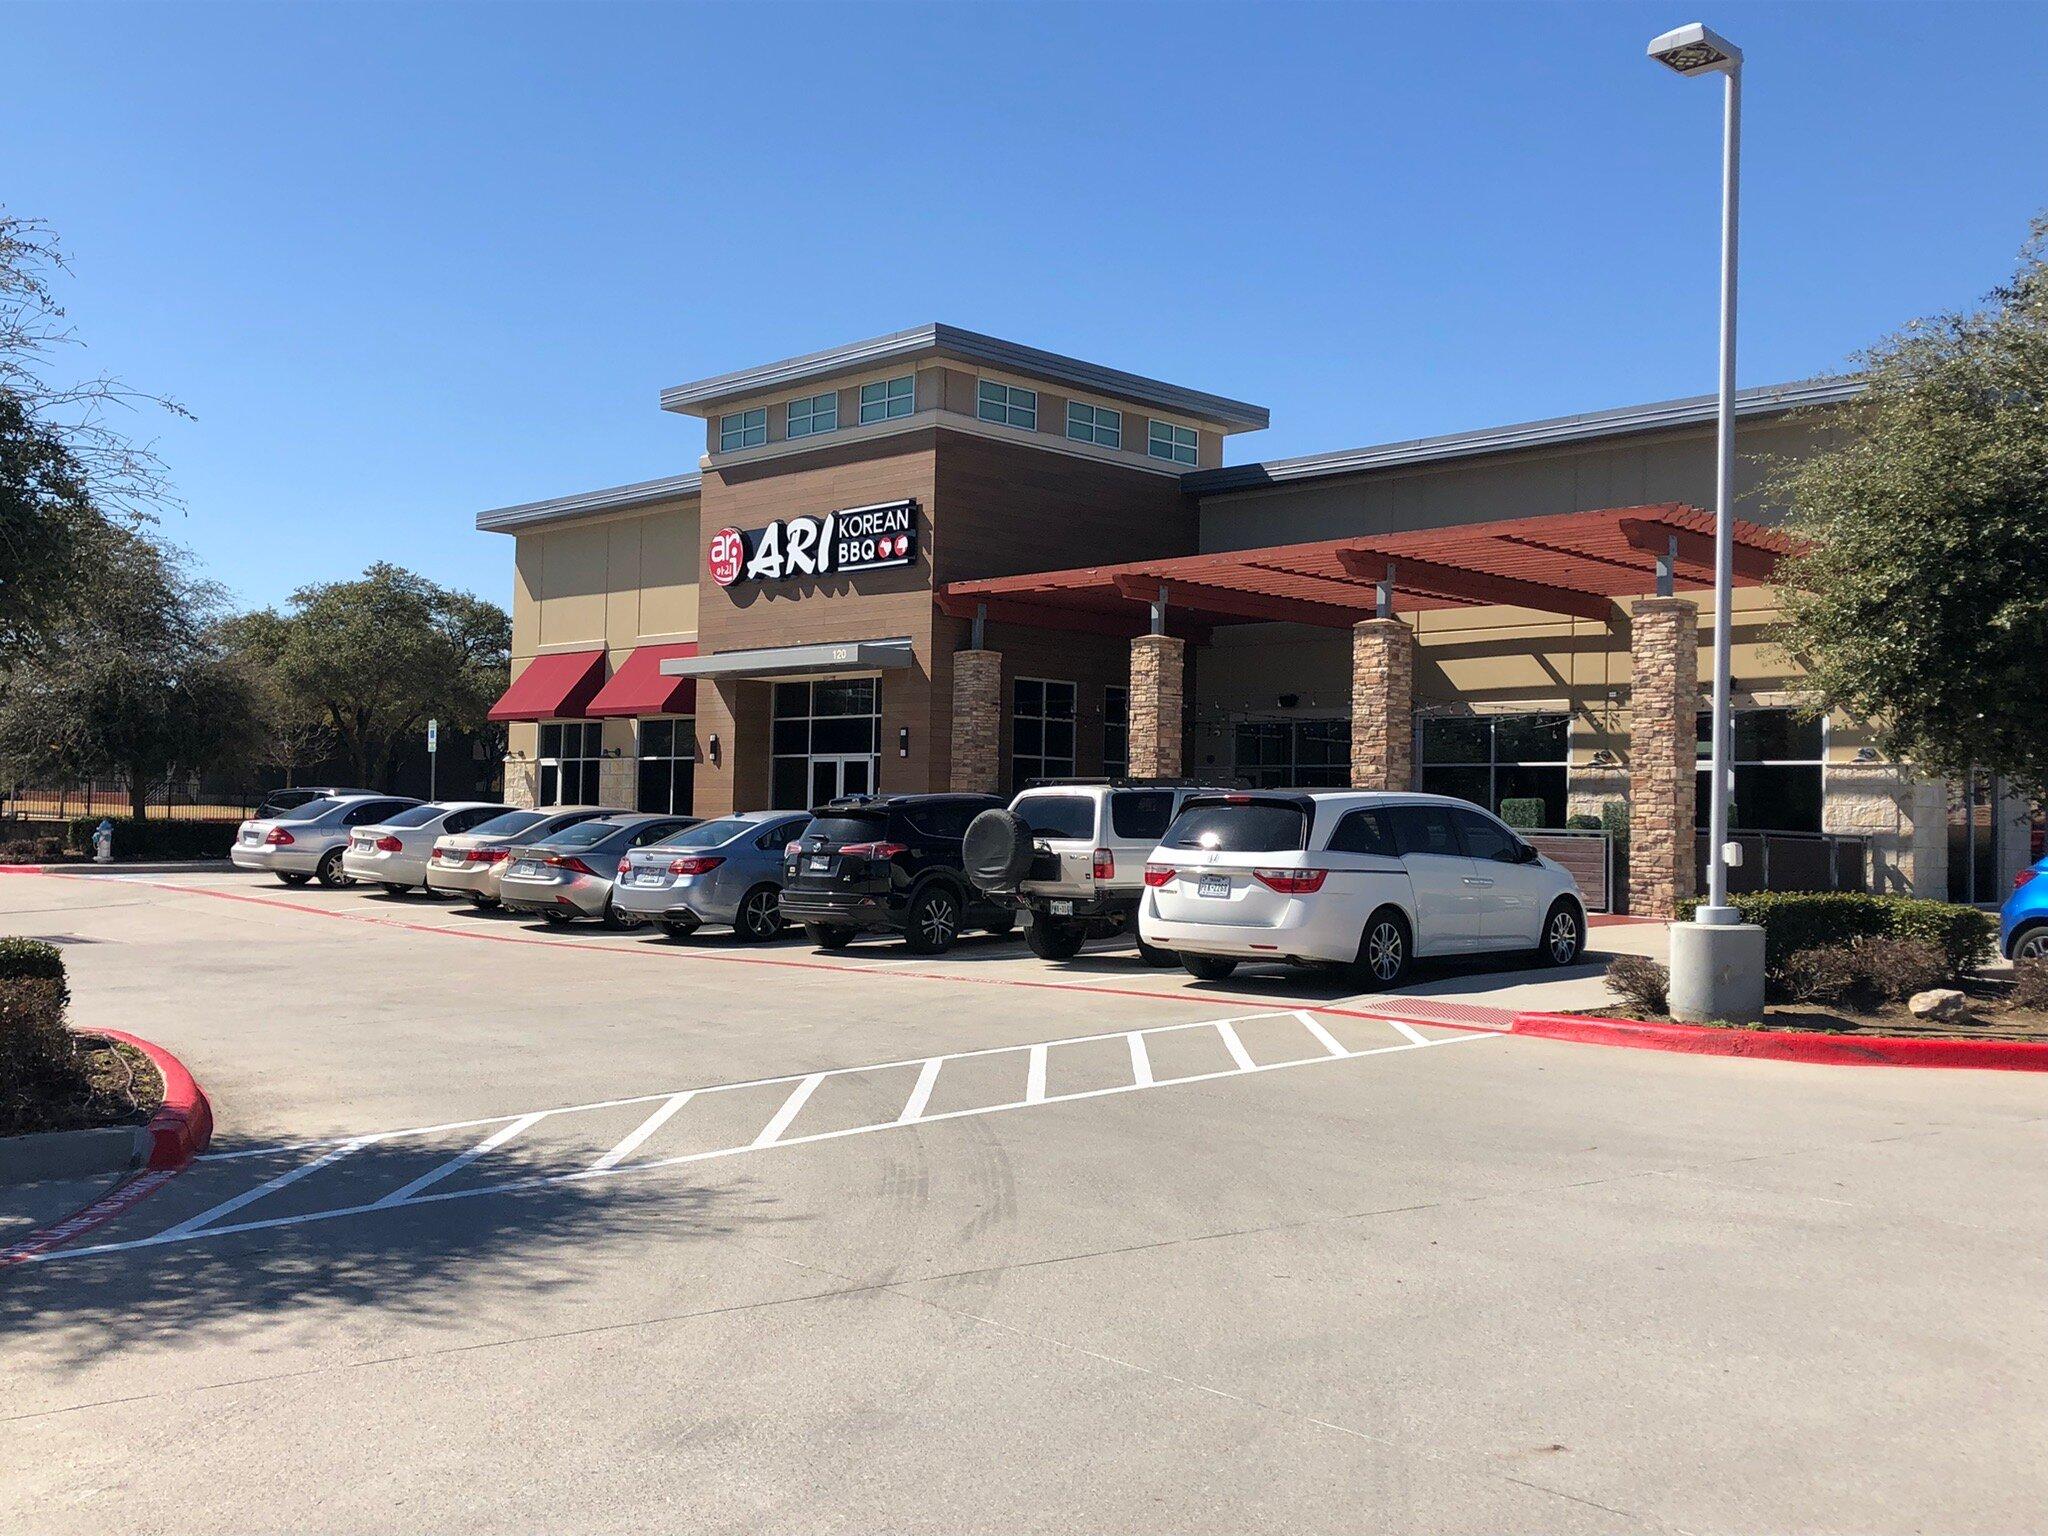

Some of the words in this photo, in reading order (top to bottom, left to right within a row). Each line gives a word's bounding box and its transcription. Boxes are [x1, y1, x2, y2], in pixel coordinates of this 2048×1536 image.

[839, 508, 909, 538] KOREAN
[711, 533, 741, 581] ari
[747, 514, 834, 579] ARI
[839, 539, 875, 564] BBQ
[716, 565, 732, 576] 아리
[832, 649, 847, 660] 120
